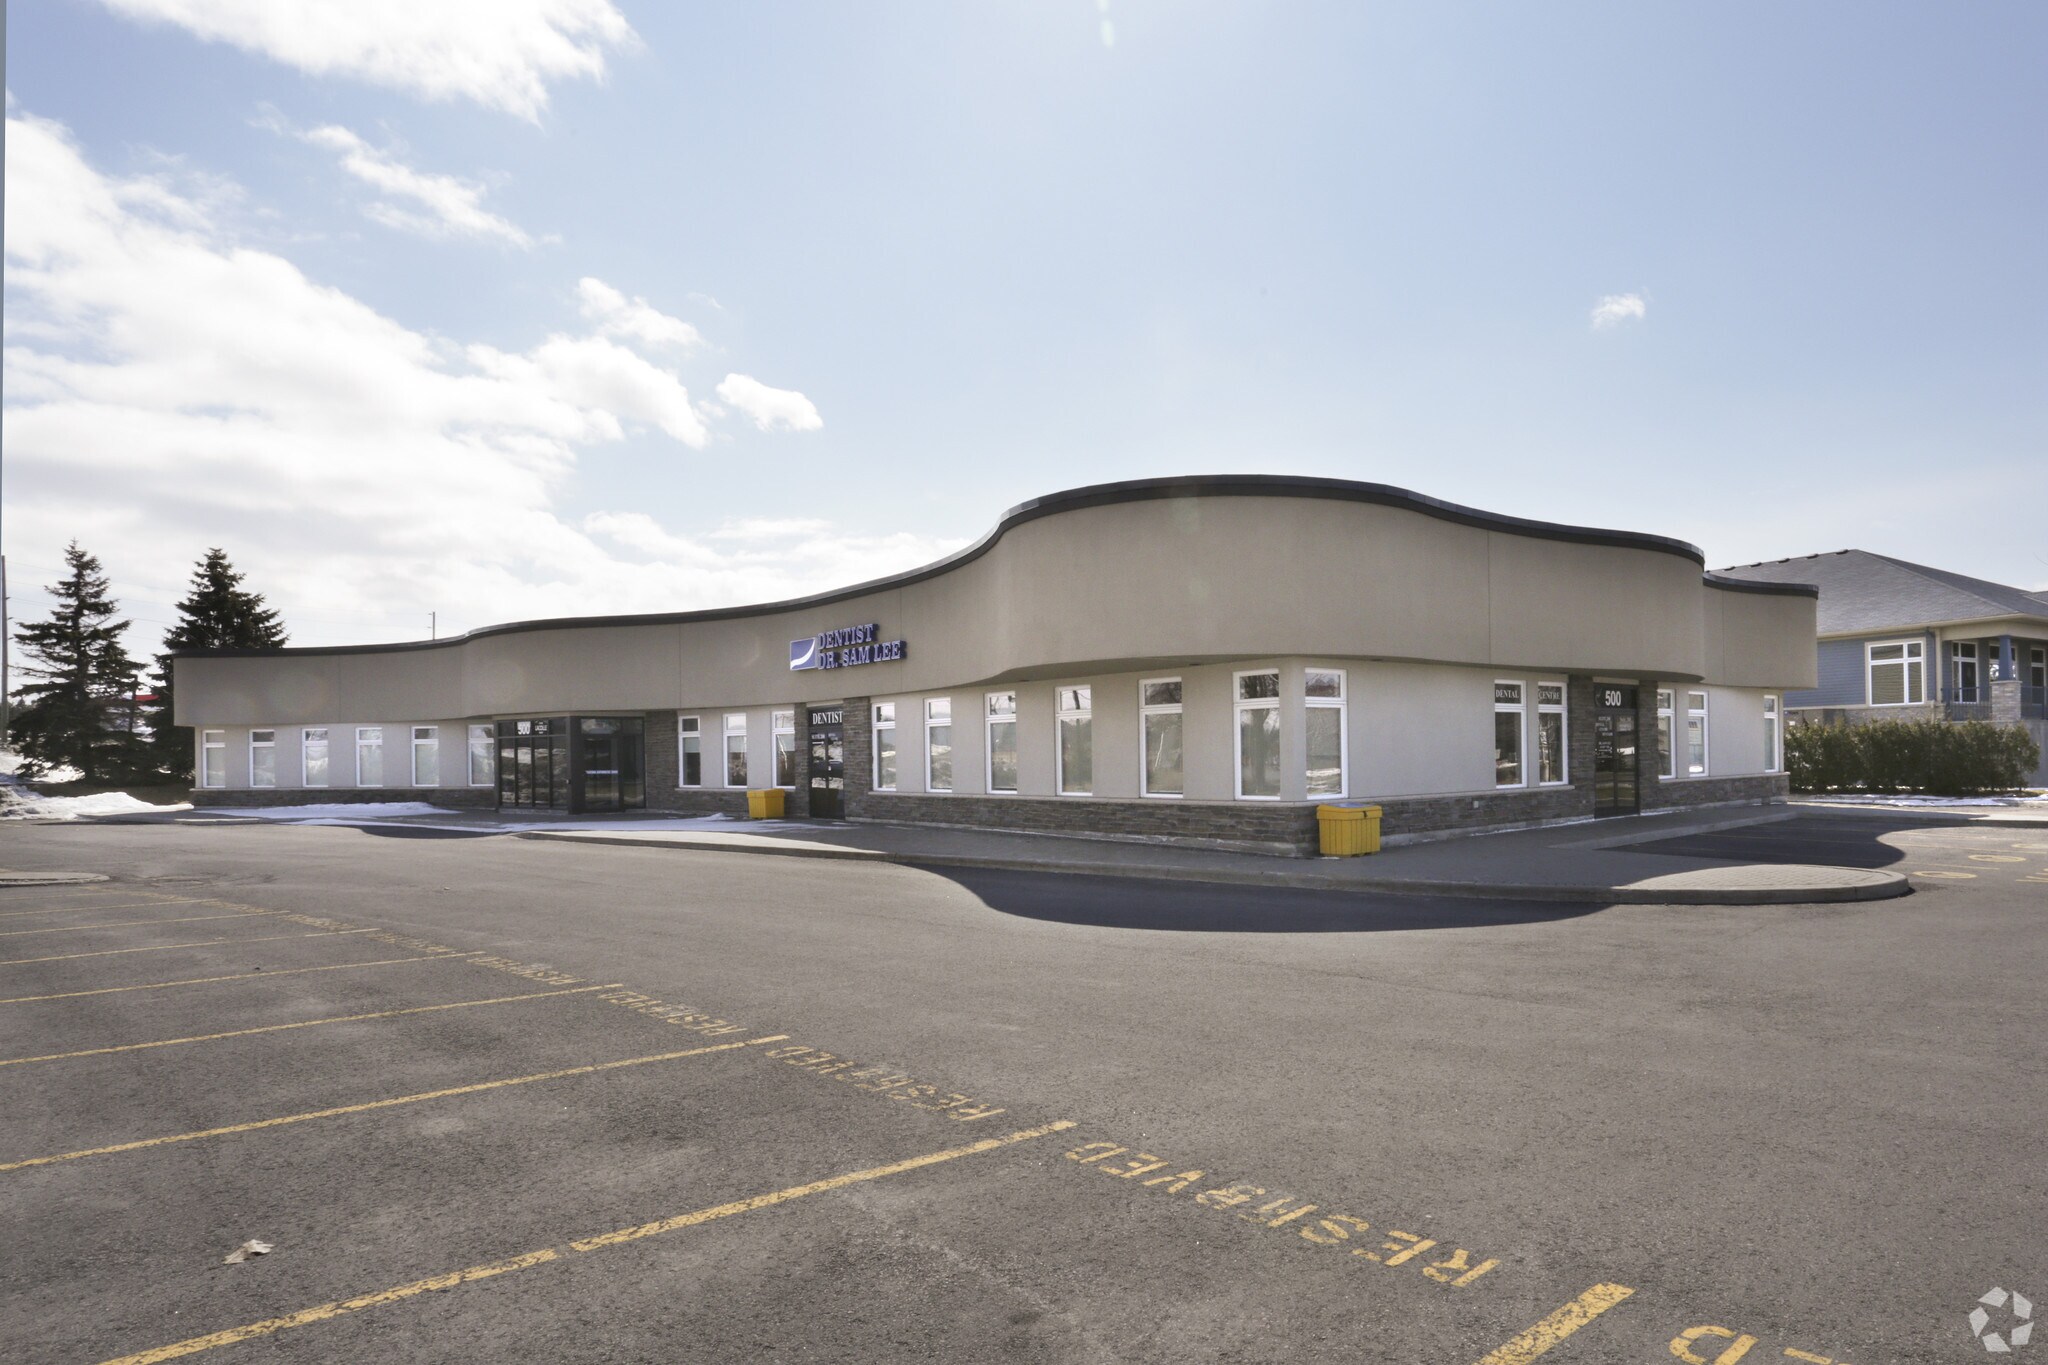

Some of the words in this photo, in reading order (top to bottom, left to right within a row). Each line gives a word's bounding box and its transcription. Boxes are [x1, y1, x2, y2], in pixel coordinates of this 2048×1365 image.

[817, 623, 876, 650] DENTIST
[817, 651, 839, 670] DR.
[842, 646, 871, 668] SAM
[873, 640, 903, 662] LEE
[1495, 689, 1519, 699] DENTAL
[1538, 689, 1561, 701] CENTRE
[1604, 690, 1622, 706] 500
[812, 710, 843, 725] DENTIST
[517, 721, 531, 735] 500
[1065, 1142, 1499, 1287] RESERVED
